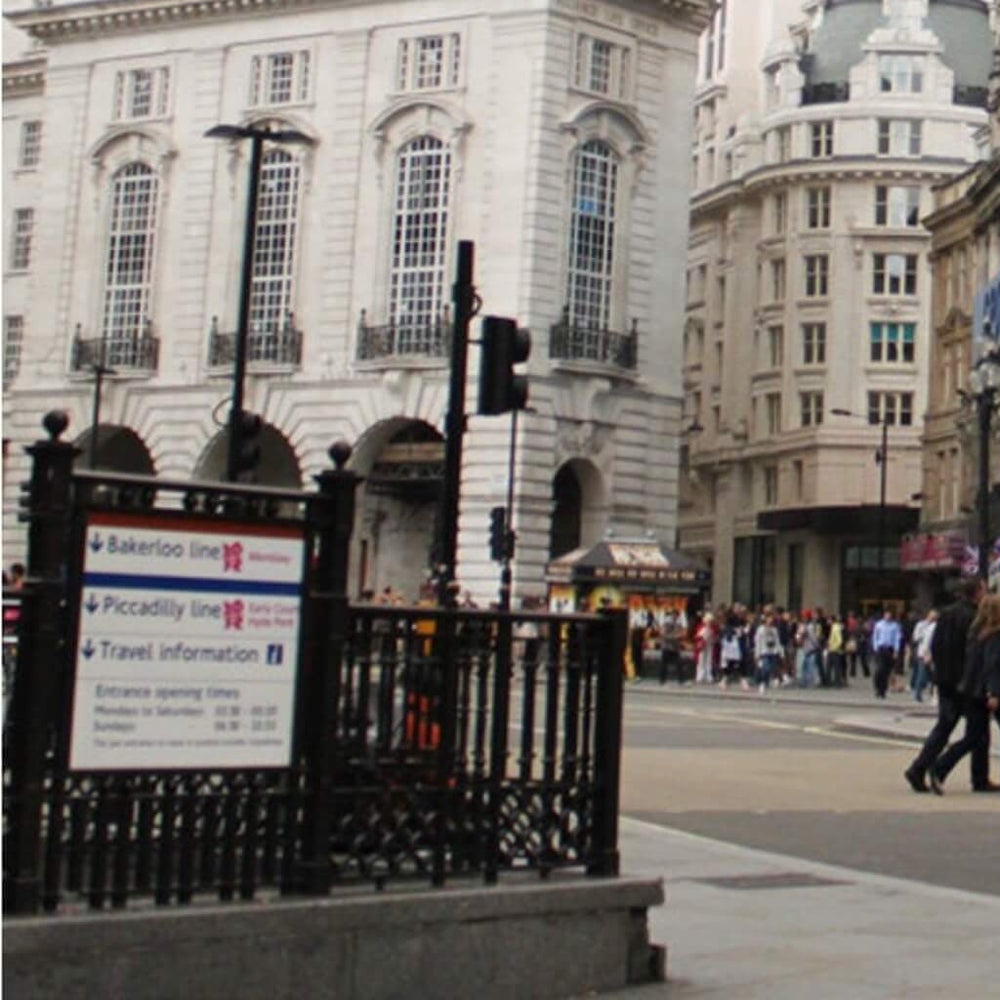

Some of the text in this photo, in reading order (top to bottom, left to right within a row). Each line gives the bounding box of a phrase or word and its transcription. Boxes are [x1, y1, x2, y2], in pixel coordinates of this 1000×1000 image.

[107, 535, 220, 560] Bakerloo line
[103, 596, 221, 621] Piccadilly line
[100, 641, 259, 664] Travel information
